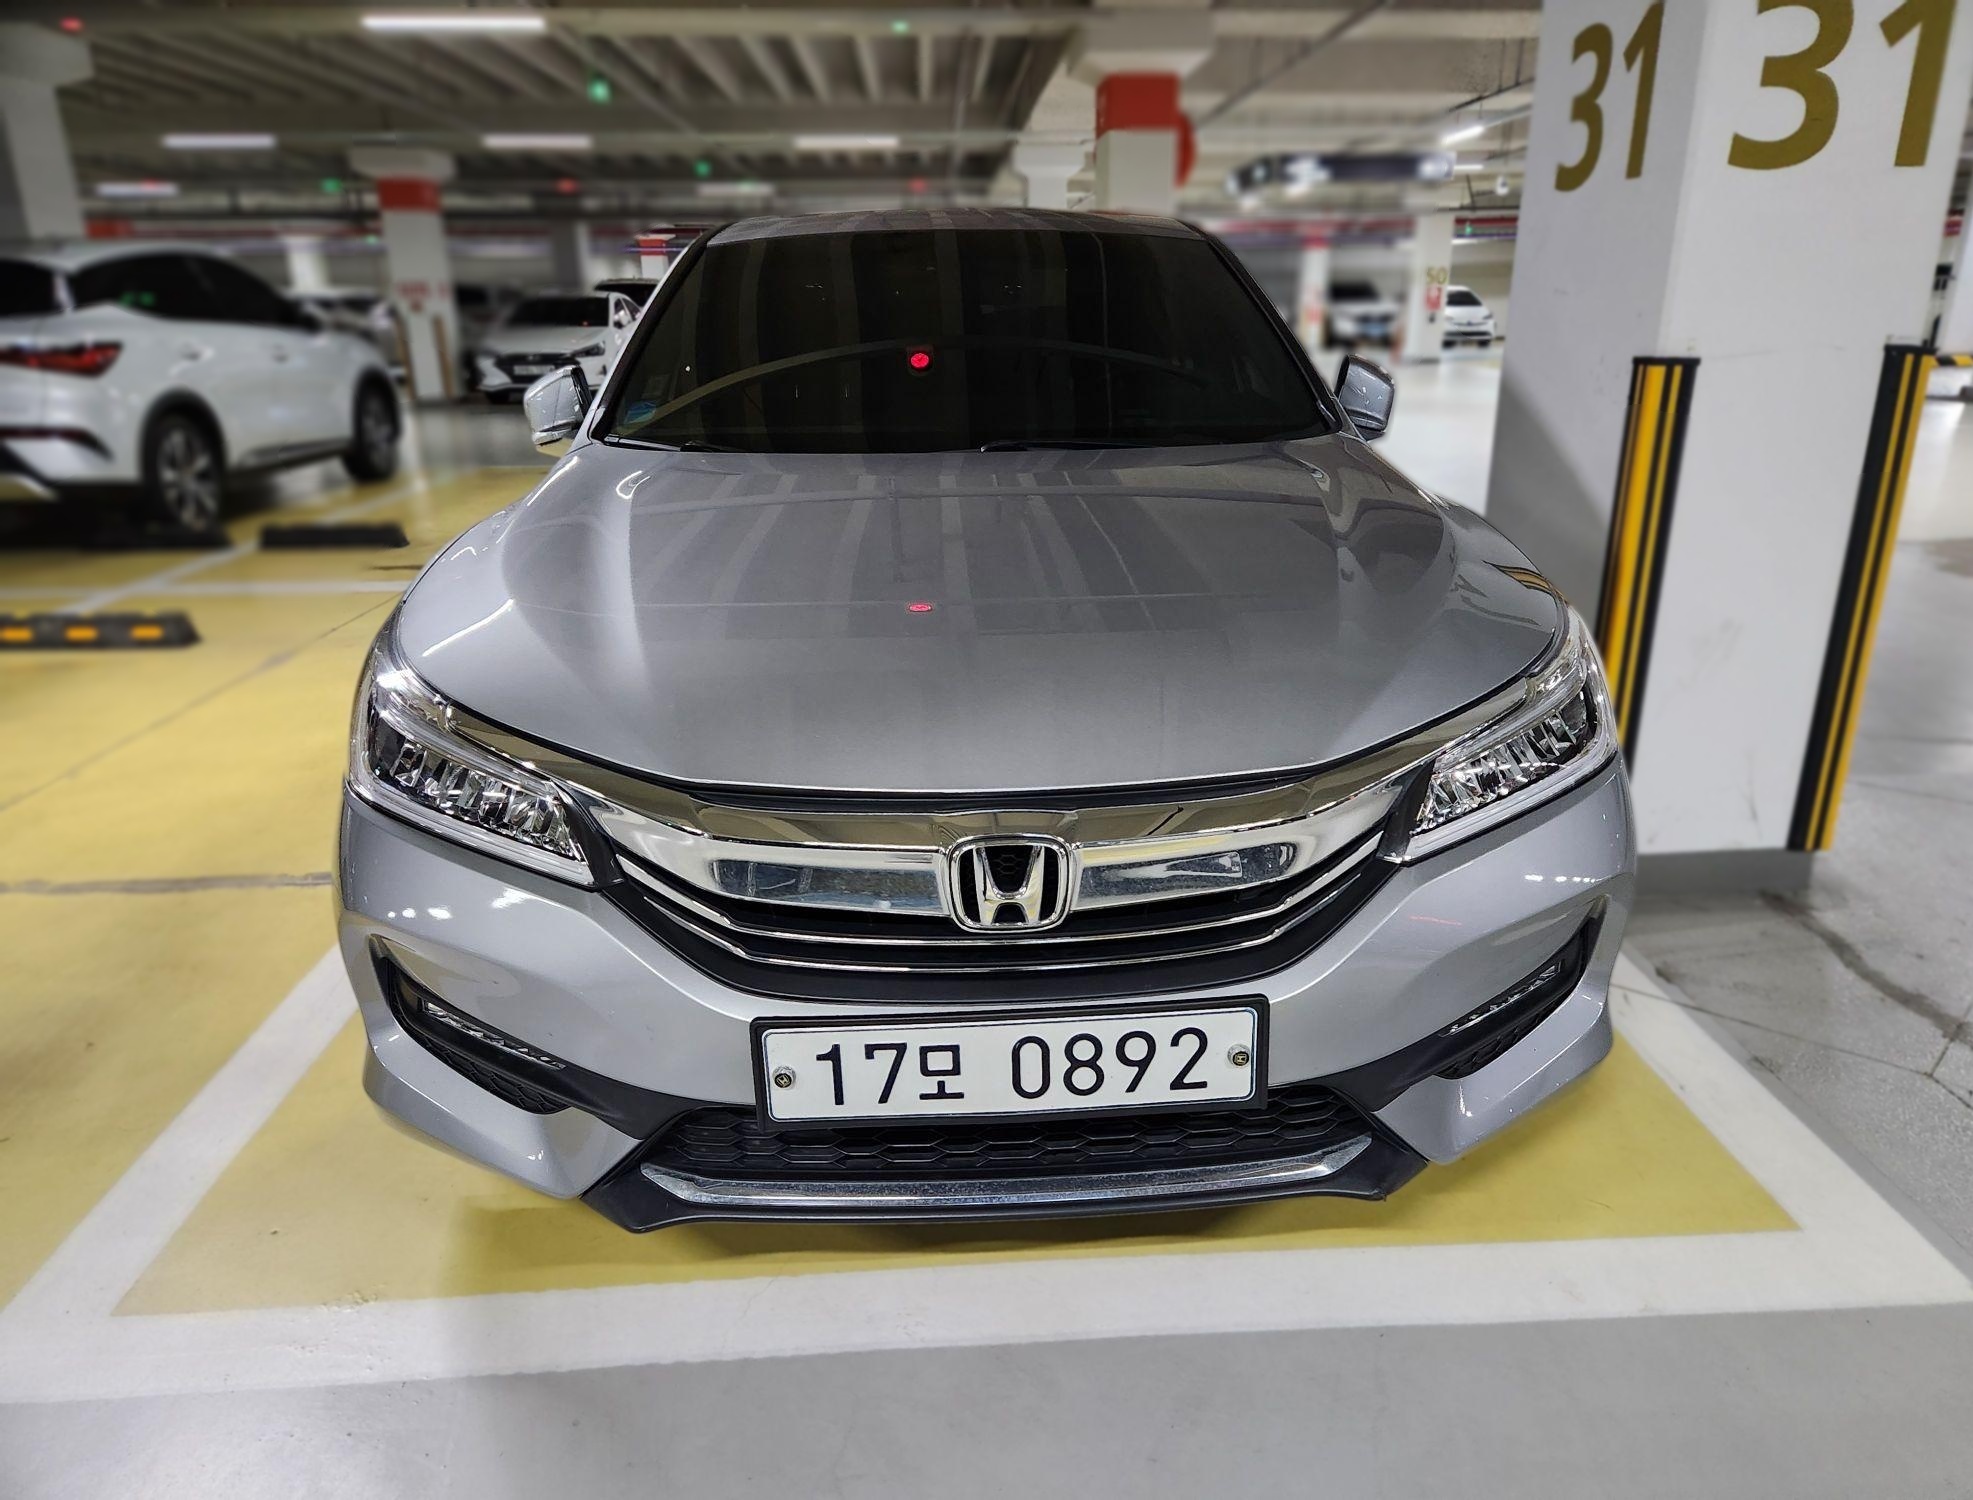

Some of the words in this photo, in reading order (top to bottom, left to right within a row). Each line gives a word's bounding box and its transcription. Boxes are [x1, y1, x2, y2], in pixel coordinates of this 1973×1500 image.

[1554, 0, 1665, 192] 31
[1727, 0, 1957, 170] 31
[815, 1042, 965, 1106] 17모
[1011, 1026, 1209, 1099] 0892
